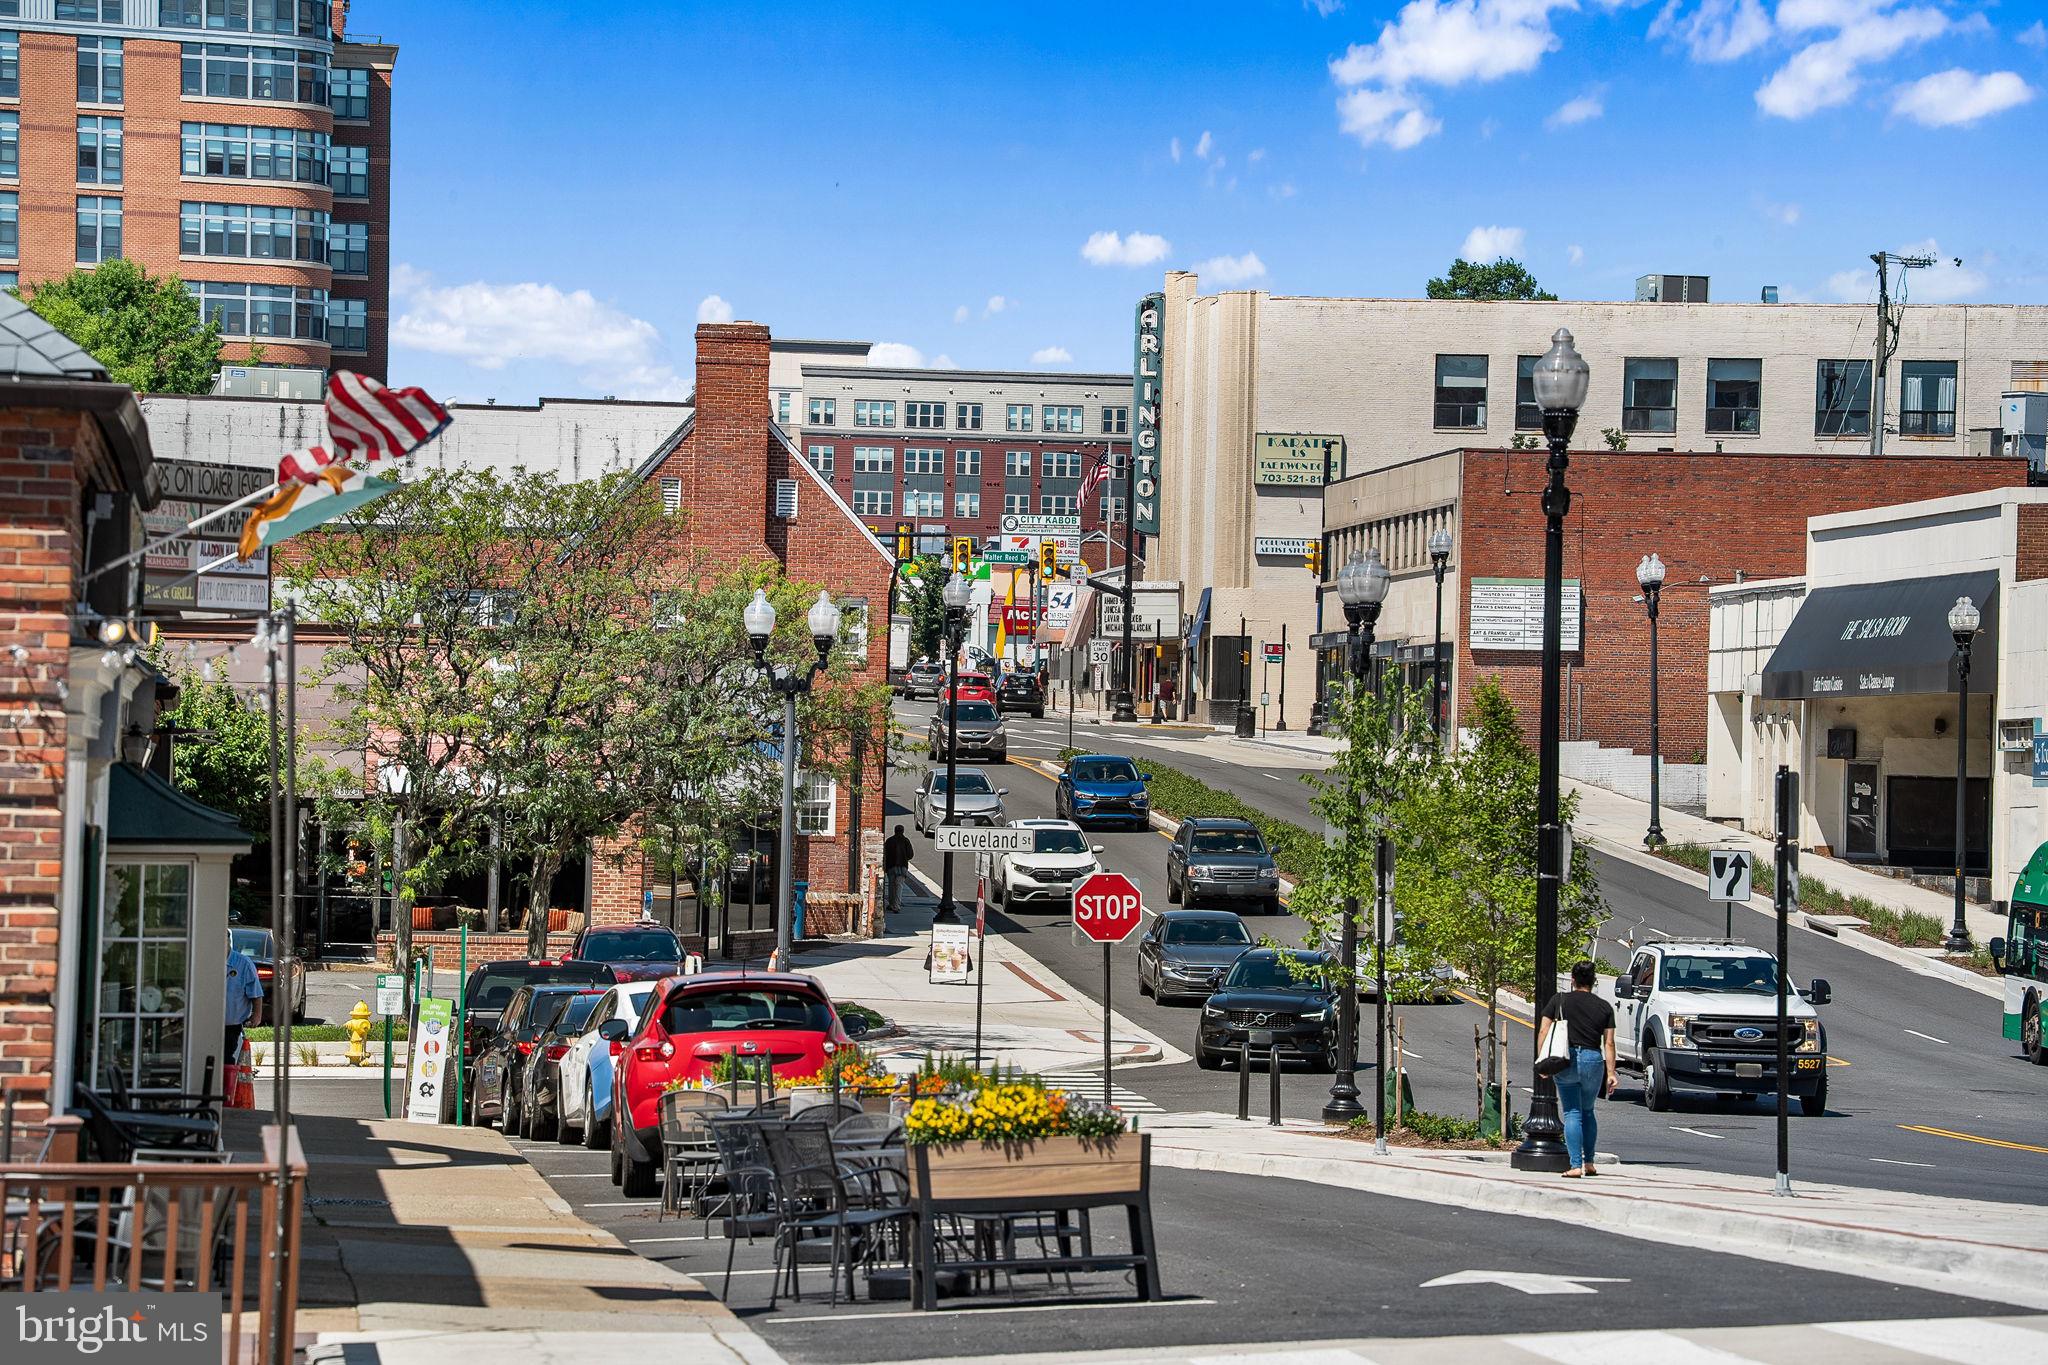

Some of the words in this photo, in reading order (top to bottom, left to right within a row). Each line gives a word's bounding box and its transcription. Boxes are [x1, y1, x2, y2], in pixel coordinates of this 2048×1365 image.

[1136, 309, 1159, 522] ARLINGTON
[1291, 449, 1306, 458] US
[1280, 462, 1308, 470] KWON
[174, 466, 194, 493] ON
[198, 468, 234, 497] LOWER
[1262, 474, 1334, 484] 703-521-810
[1020, 515, 1042, 524] CITY
[1045, 516, 1077, 525] KABOB
[984, 553, 1003, 561] Walter
[171, 586, 194, 600] GRILL
[1050, 592, 1074, 609] 54
[1105, 624, 1124, 632] MICHAE
[1129, 624, 1152, 632] ALASCAK
[1840, 620, 1862, 641] THE
[1856, 617, 1887, 640] SALSA
[1880, 615, 1911, 637] ROOM
[1092, 652, 1108, 662] 30
[938, 834, 944, 843] S
[948, 831, 1018, 849] Cleveland
[1021, 836, 1031, 845] St
[1078, 894, 1138, 920] STOP
[377, 977, 386, 985] 15
[429, 1003, 441, 1012] play
[1741, 1030, 1756, 1039] Ford
[1797, 1059, 1821, 1069] 5527
